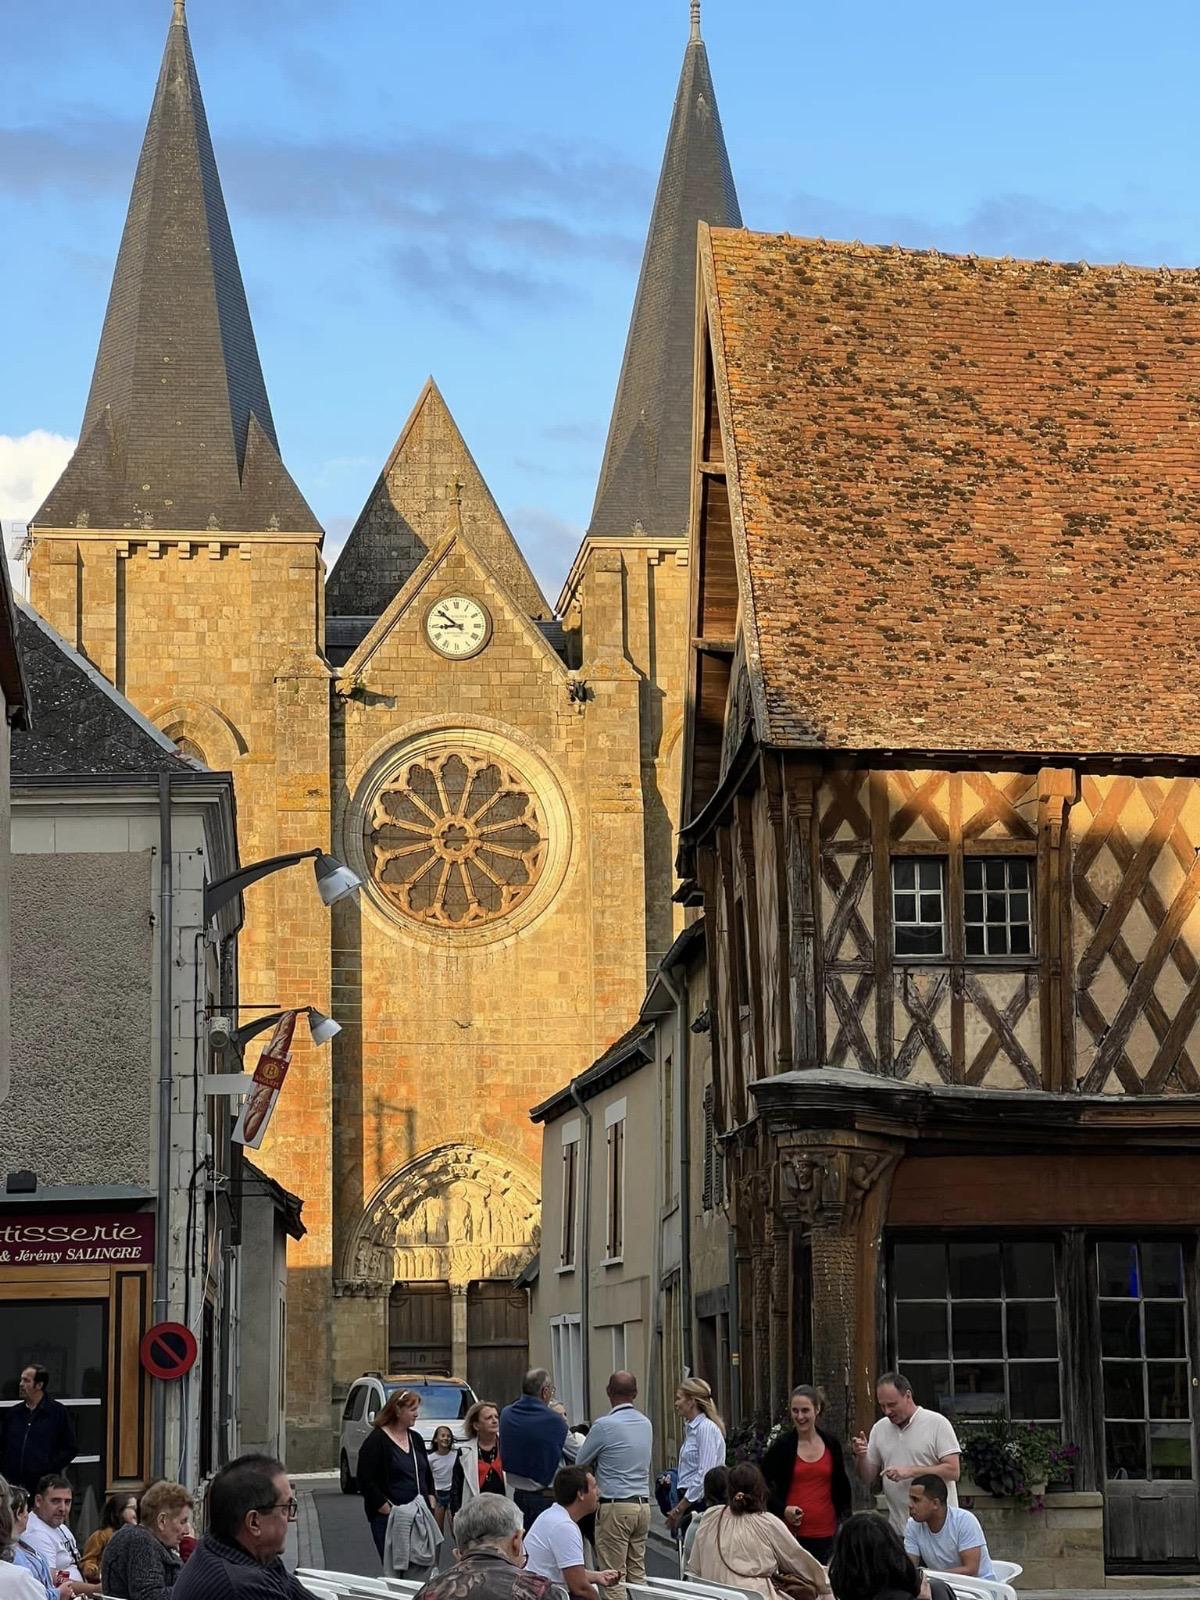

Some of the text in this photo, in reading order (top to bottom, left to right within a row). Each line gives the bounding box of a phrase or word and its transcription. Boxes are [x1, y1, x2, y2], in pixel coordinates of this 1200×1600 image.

[0, 1246, 142, 1263] & Jérémy SALINGRE
